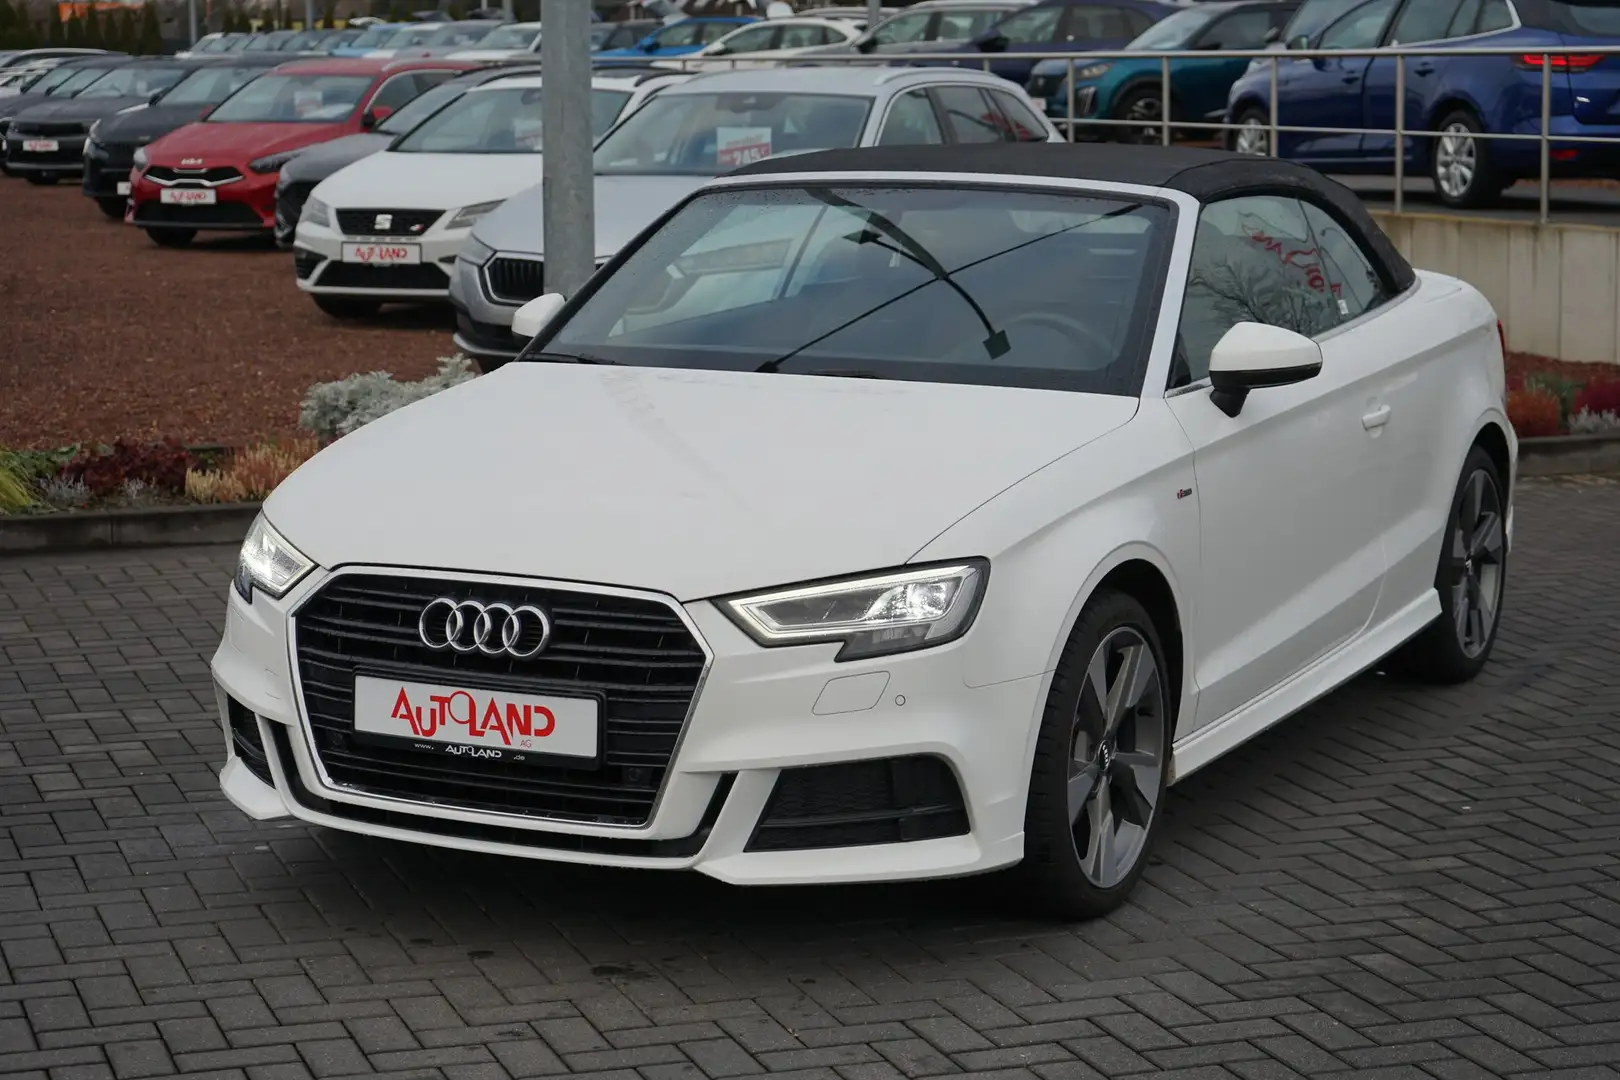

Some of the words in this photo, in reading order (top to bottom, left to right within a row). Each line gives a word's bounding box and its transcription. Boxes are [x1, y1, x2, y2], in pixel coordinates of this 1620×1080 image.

[390, 686, 556, 746] AUTOLAND
[413, 742, 435, 750] www.
[445, 744, 502, 759] AUTOLAND
[519, 739, 532, 749] AG
